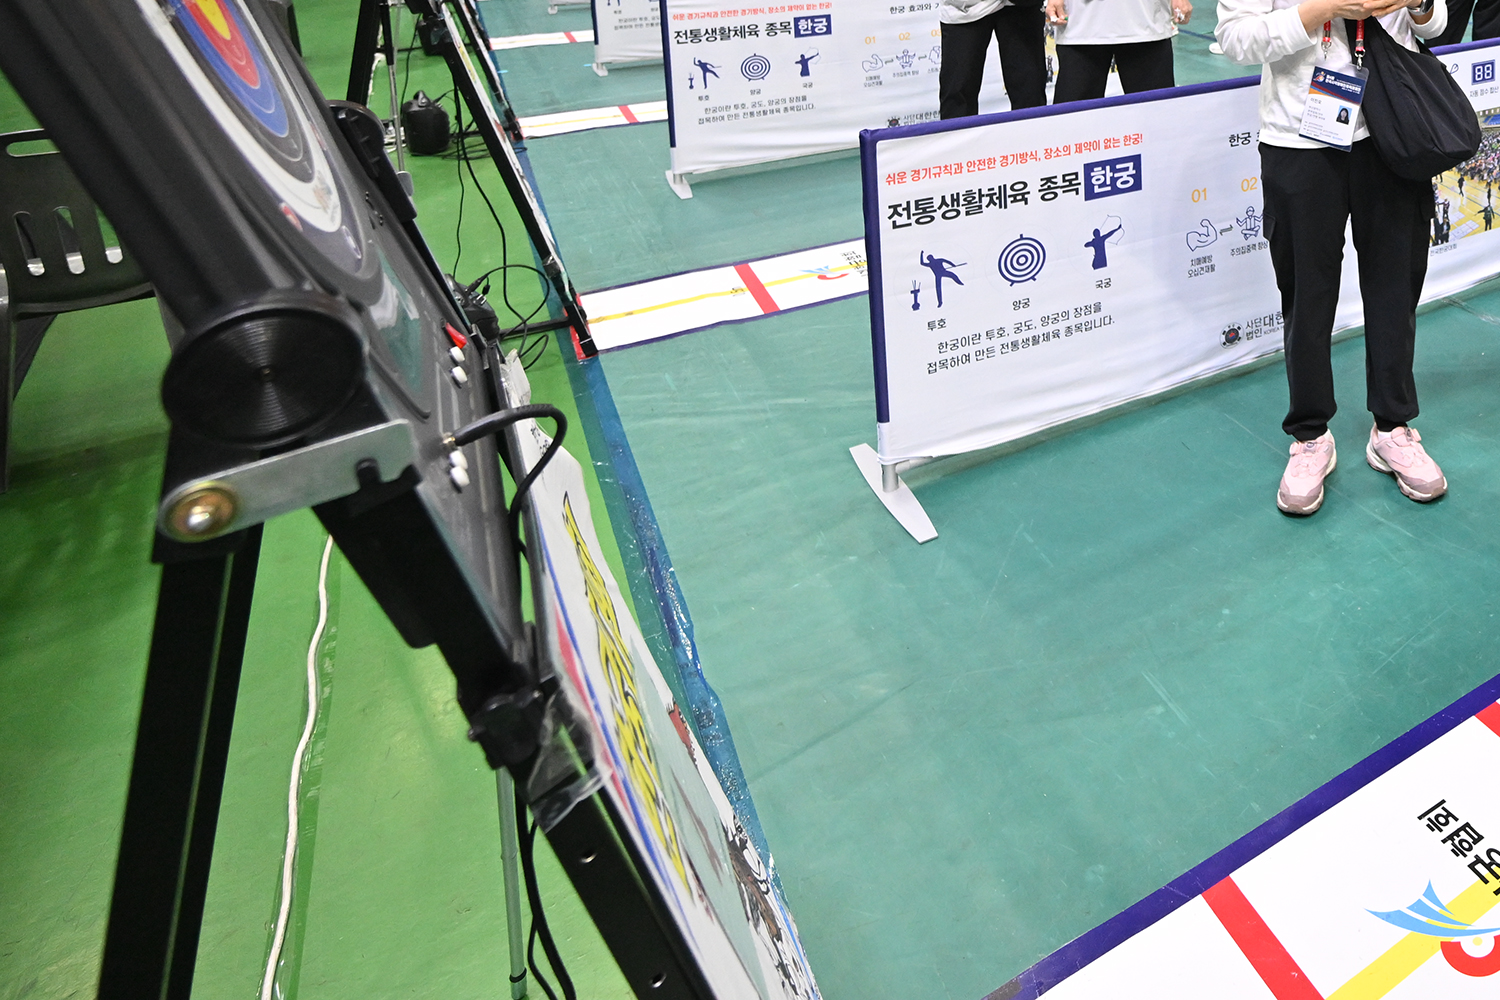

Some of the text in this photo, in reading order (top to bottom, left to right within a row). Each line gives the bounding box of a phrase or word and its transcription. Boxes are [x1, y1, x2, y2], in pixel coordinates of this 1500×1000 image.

[687, 11, 719, 20] 경기규칙과
[720, 9, 739, 18] 안전한
[740, 7, 767, 16] 경기방식,
[768, 6, 786, 14] 장소의
[787, 4, 804, 12] 제약이
[890, 3, 932, 14] 한궁 효과와
[674, 17, 829, 44] 전통생활체육 종목 한궁
[865, 36, 876, 44] 01
[899, 32, 910, 41] 02
[1470, 90, 1478, 98] 자동
[1229, 132, 1251, 147] 한궁
[885, 132, 1143, 186] 쉬운 경기규칙과 안전한 경기방식, 장소의 제약이 없는 한궁!
[887, 161, 1136, 230] 전통생활체육 종목 한궁
[1192, 177, 1258, 202] 01 02
[1230, 243, 1257, 256] 주의집중력
[1095, 277, 1113, 290] 국궁
[1012, 297, 1031, 311] 양궁
[927, 318, 947, 331] 투호
[937, 302, 1103, 354] 한궁이란 투호, 궁도, 양궁의 장점을
[1246, 317, 1262, 330] 사단
[1246, 328, 1263, 341] 법인
[927, 316, 1115, 375] 접목하여 만든 전통생활체육 종목입니다.
